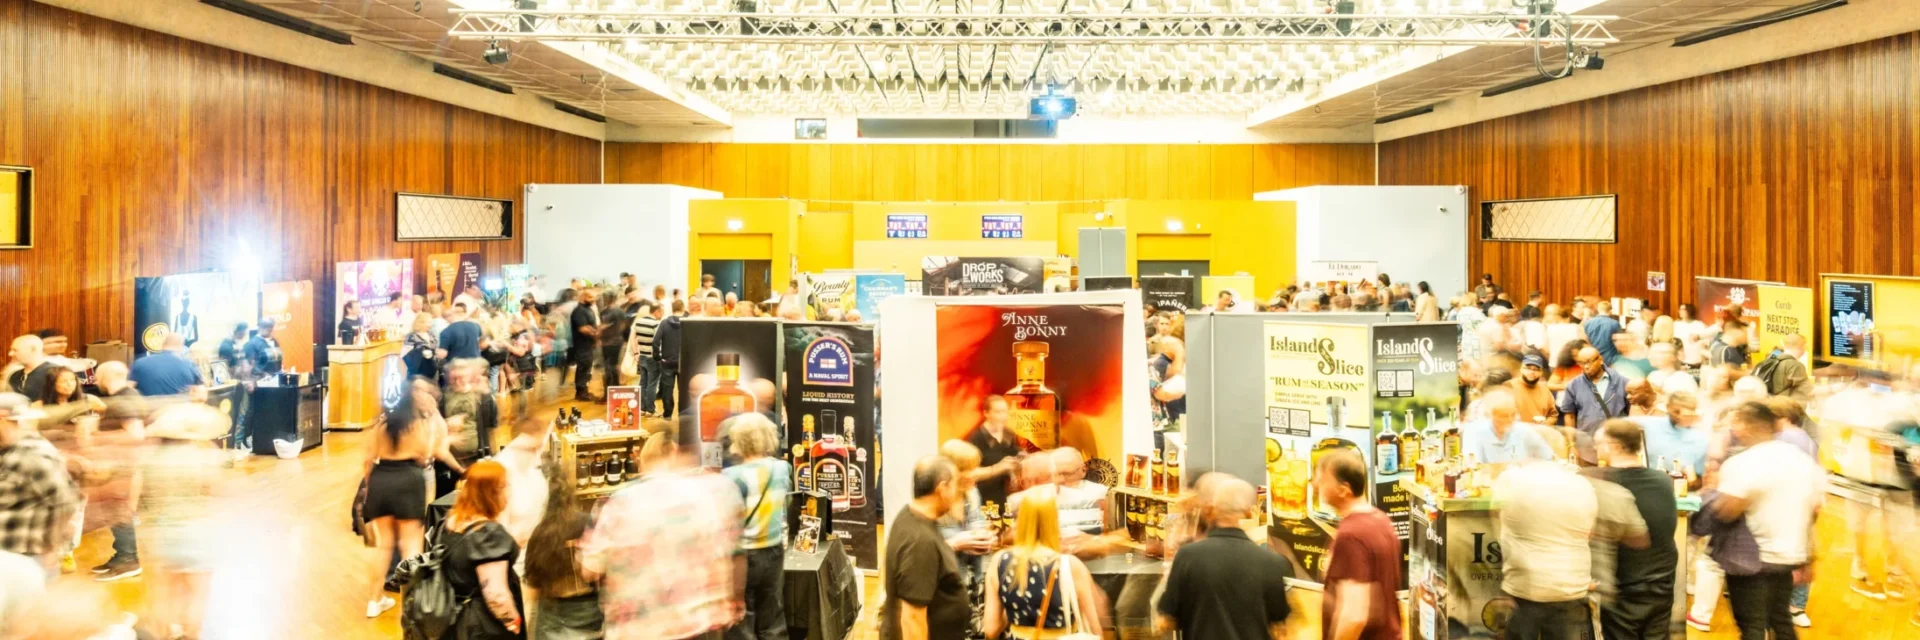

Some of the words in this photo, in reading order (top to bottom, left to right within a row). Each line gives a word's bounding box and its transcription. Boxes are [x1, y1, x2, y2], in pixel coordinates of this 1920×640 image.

[962, 262, 997, 277] DROP
[970, 270, 1004, 283] WORKS
[813, 280, 850, 295] Bounty
[1001, 311, 1049, 327] ANNE
[1766, 314, 1782, 325] NEXT
[1014, 326, 1067, 340] BONNY
[1269, 336, 1318, 353] Island
[1376, 338, 1419, 355] Island
[1317, 338, 1364, 376] Slice
[1419, 337, 1457, 375] Slice
[826, 392, 855, 400] HISTORY
[1383, 494, 1405, 503] made
[1471, 532, 1503, 564] Is
[1471, 573, 1493, 582] OVER
